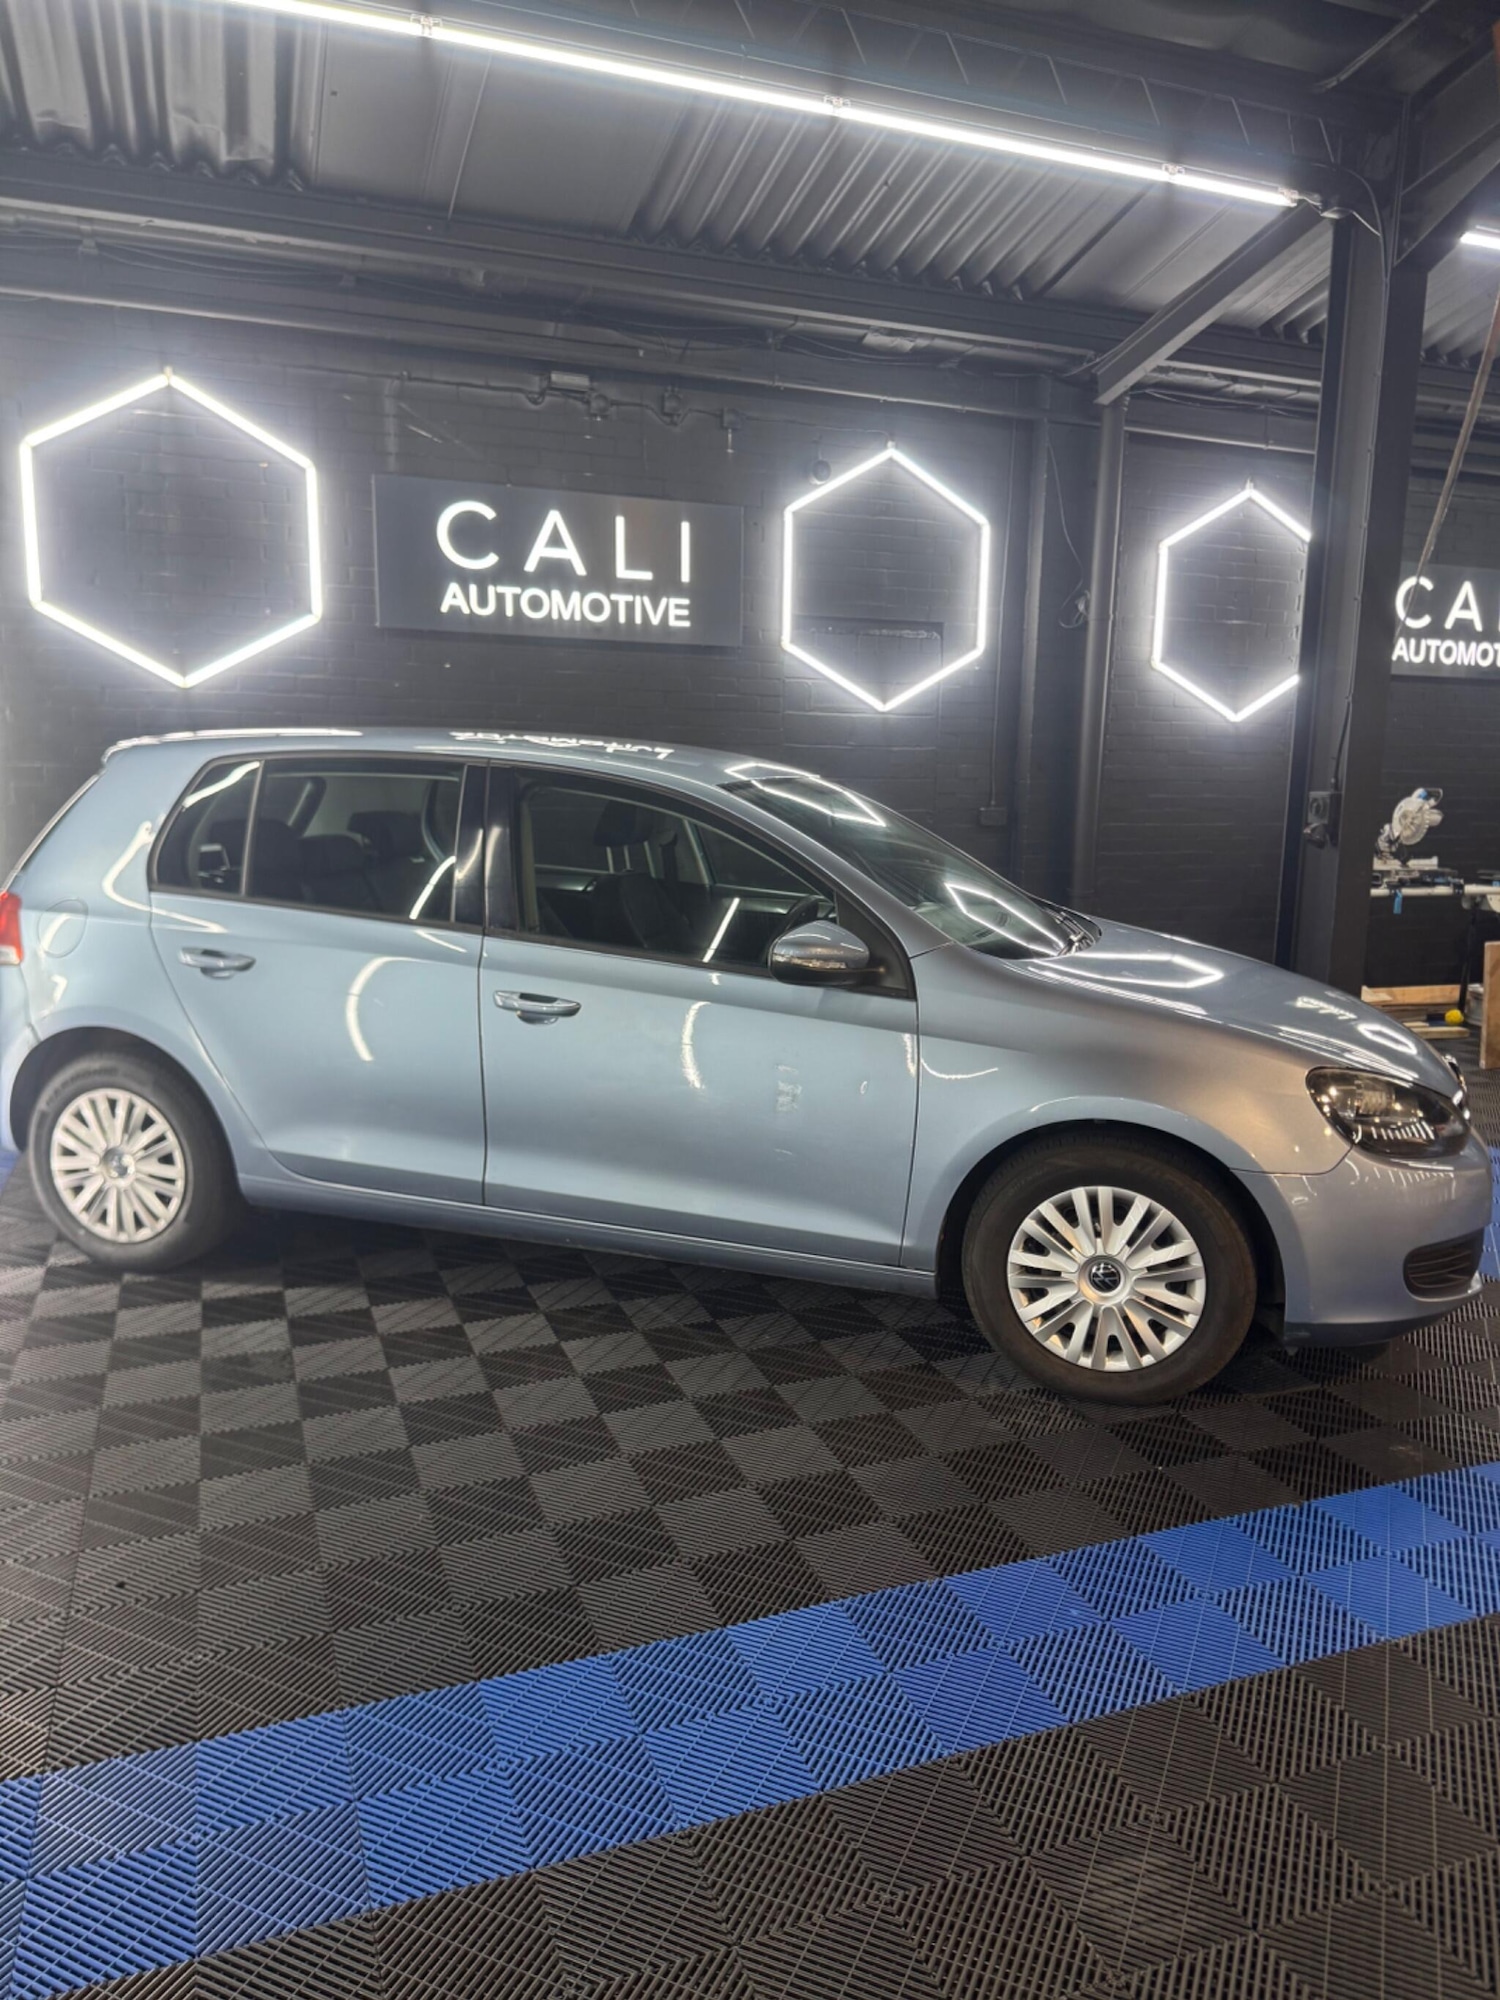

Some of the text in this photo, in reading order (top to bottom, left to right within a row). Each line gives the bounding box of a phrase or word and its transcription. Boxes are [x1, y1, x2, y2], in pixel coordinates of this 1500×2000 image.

[436, 500, 690, 583] CALI
[440, 582, 691, 627] AUTOMOTIVE
[1395, 575, 1500, 633] CA
